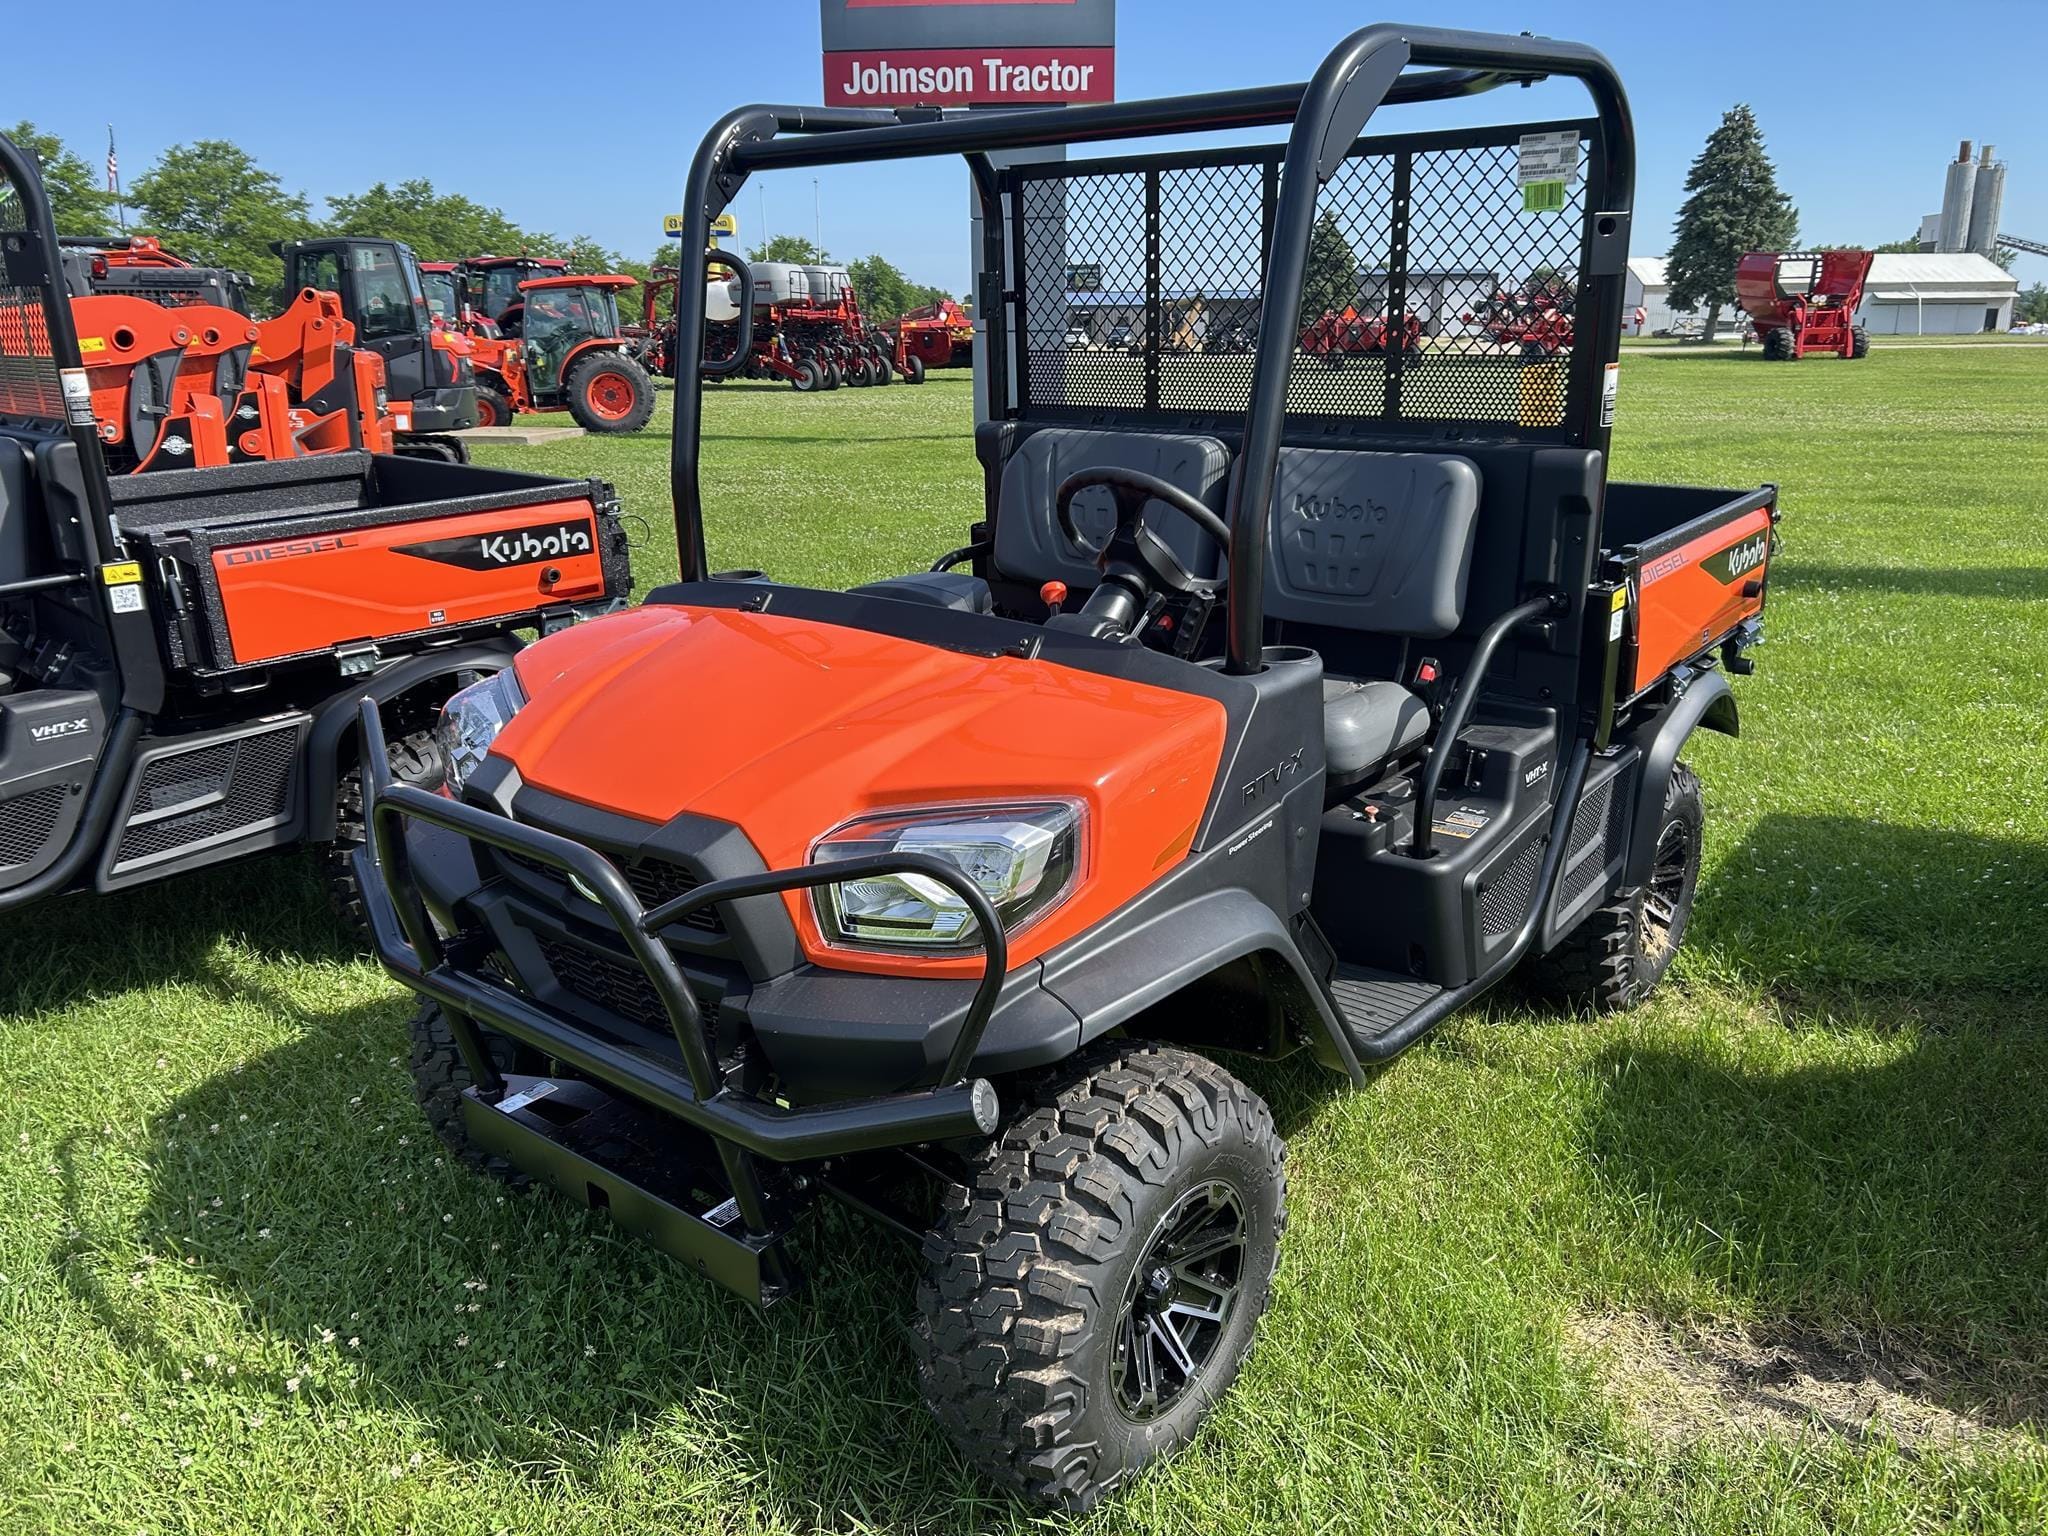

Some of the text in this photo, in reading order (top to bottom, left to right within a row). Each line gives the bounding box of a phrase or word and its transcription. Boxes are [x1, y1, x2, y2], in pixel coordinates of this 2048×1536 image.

[843, 58, 1094, 95] Johnson Tractor
[1291, 494, 1388, 521] Kubota
[224, 537, 359, 566] DIESEL
[480, 526, 590, 563] Kubota
[1727, 536, 1766, 577] Kubota
[1641, 552, 1690, 585] DIESEL
[31, 718, 89, 738] VHT-X
[1241, 747, 1304, 807] RTV-X
[1525, 761, 1549, 784] VHT-X
